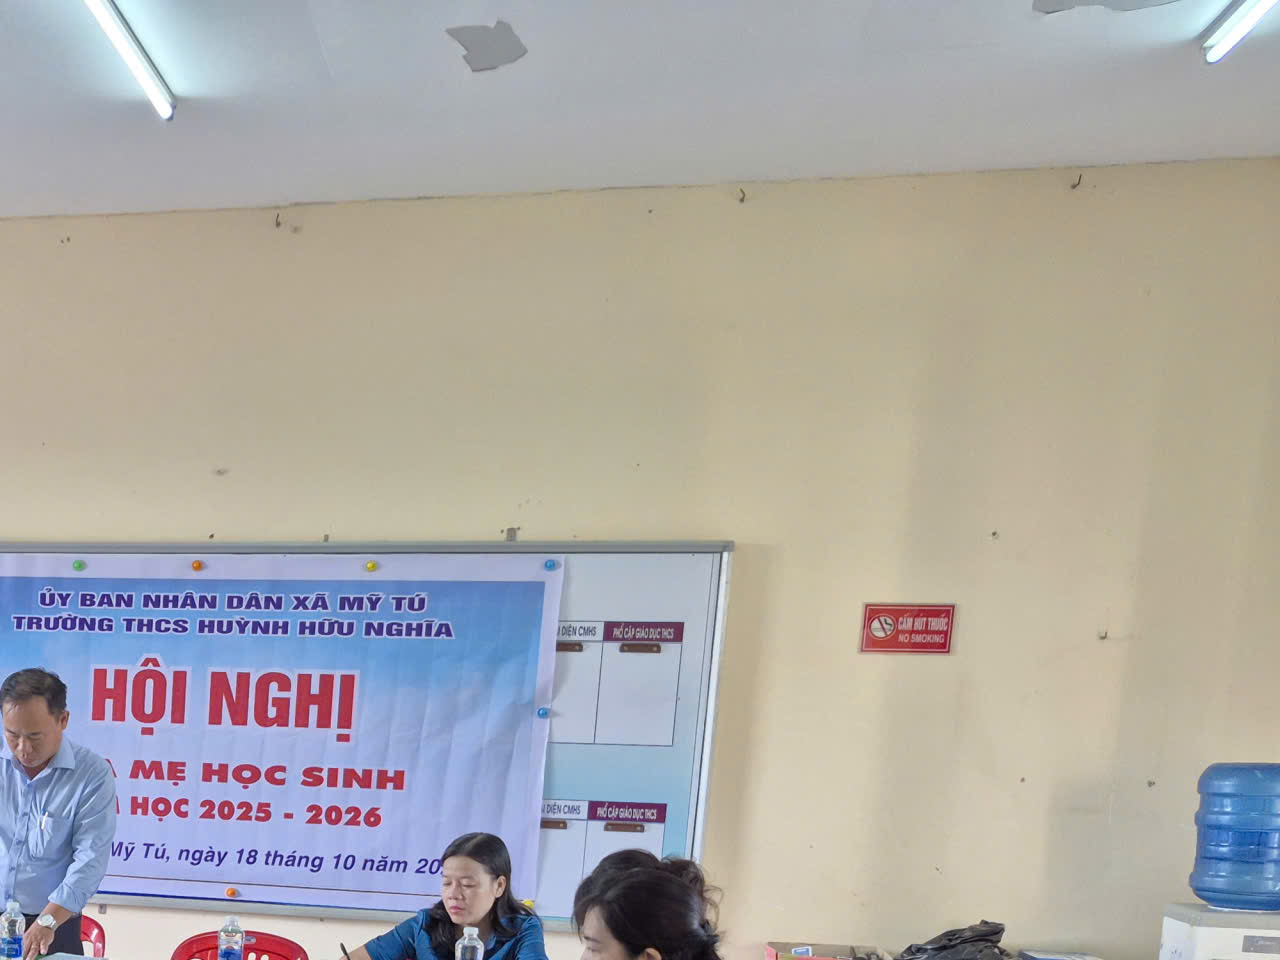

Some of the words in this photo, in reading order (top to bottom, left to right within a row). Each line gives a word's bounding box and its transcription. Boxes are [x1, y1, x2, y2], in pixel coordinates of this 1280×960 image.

[40, 588, 71, 607] ỦY
[80, 593, 133, 607] BAN
[142, 591, 217, 609] NHÂN
[226, 592, 283, 610] DÂN
[292, 593, 329, 611] XÃ
[339, 593, 382, 611] MỸ
[392, 593, 426, 611] TÚ
[13, 613, 113, 632] TRƯỜNG
[123, 618, 188, 633] THCS
[198, 617, 289, 635] HUỲNH
[299, 618, 354, 636] HỮU
[364, 619, 453, 637] NGHĨA
[578, 626, 596, 637] CMHS
[898, 633, 910, 643] NO
[911, 633, 944, 644] SMOKING
[91, 658, 187, 735] HỘI
[208, 671, 355, 742] NGHỊ
[129, 759, 186, 786] MẸ
[201, 762, 287, 789] HỌC
[300, 766, 405, 790] SINH
[130, 796, 189, 822] HỌC
[199, 799, 272, 822] 2025
[305, 804, 382, 828] 2026
[562, 804, 581, 815] CMHS
[142, 843, 170, 863] Tú,
[177, 846, 228, 867] ngày
[236, 848, 258, 865] 18
[264, 850, 324, 873] tháng
[333, 854, 356, 871] 10
[361, 856, 408, 873] năm
[415, 858, 442, 875] 20
